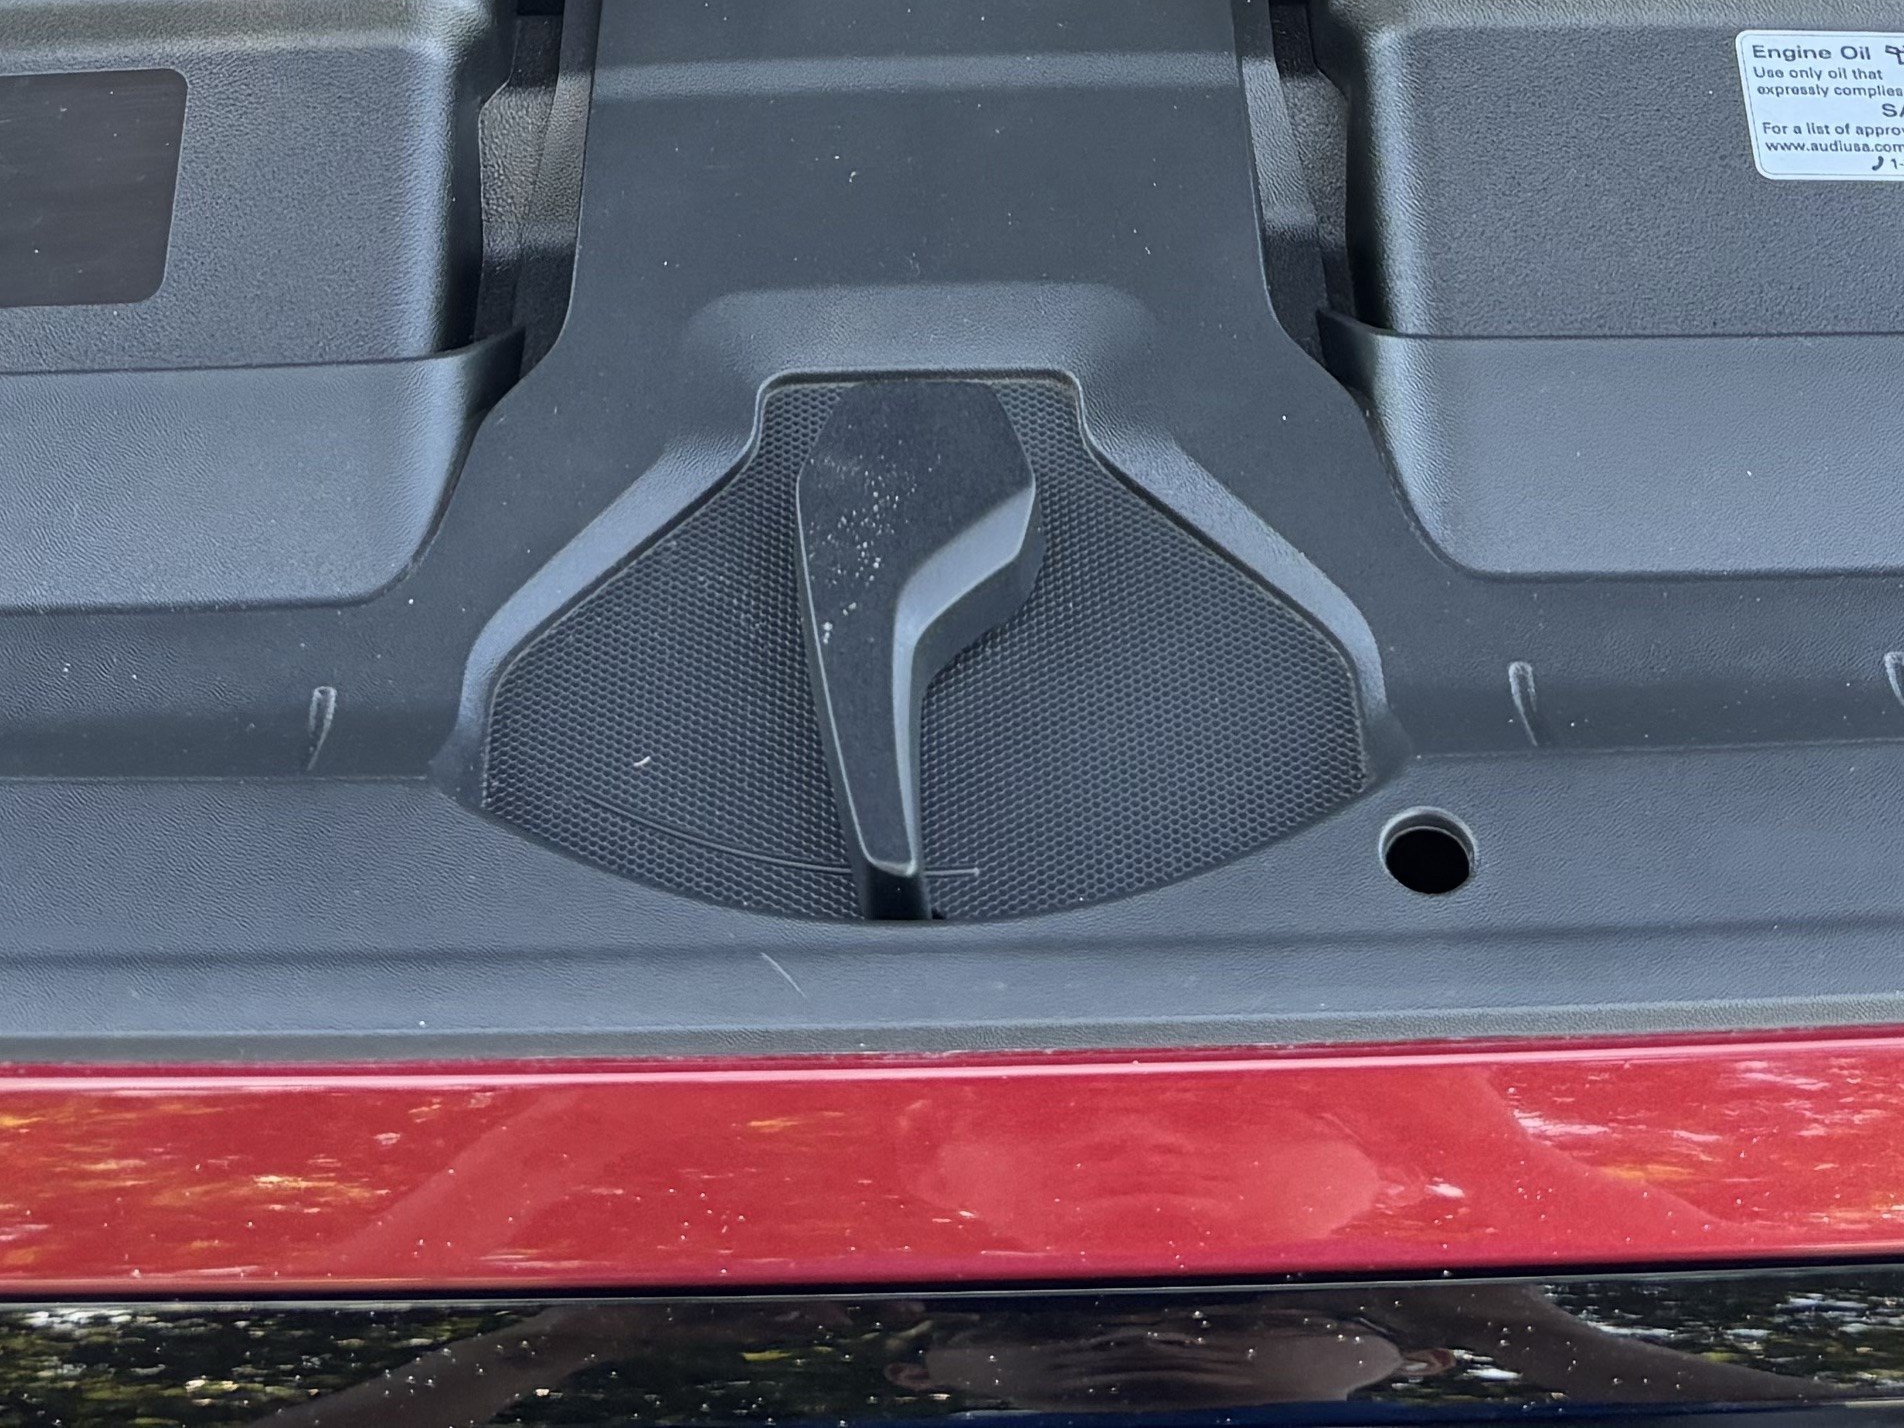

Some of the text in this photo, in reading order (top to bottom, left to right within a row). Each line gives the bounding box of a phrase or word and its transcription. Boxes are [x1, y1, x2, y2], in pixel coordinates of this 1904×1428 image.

[1752, 44, 1872, 62] Engine Oil
[1753, 66, 1883, 81] Use only oil that
[1757, 84, 1829, 98] expressly
[1834, 85, 1903, 99] complies
[1762, 122, 1787, 135] For
[1793, 125, 1802, 135] a
[1807, 122, 1829, 135] list
[1834, 123, 1850, 135] of
